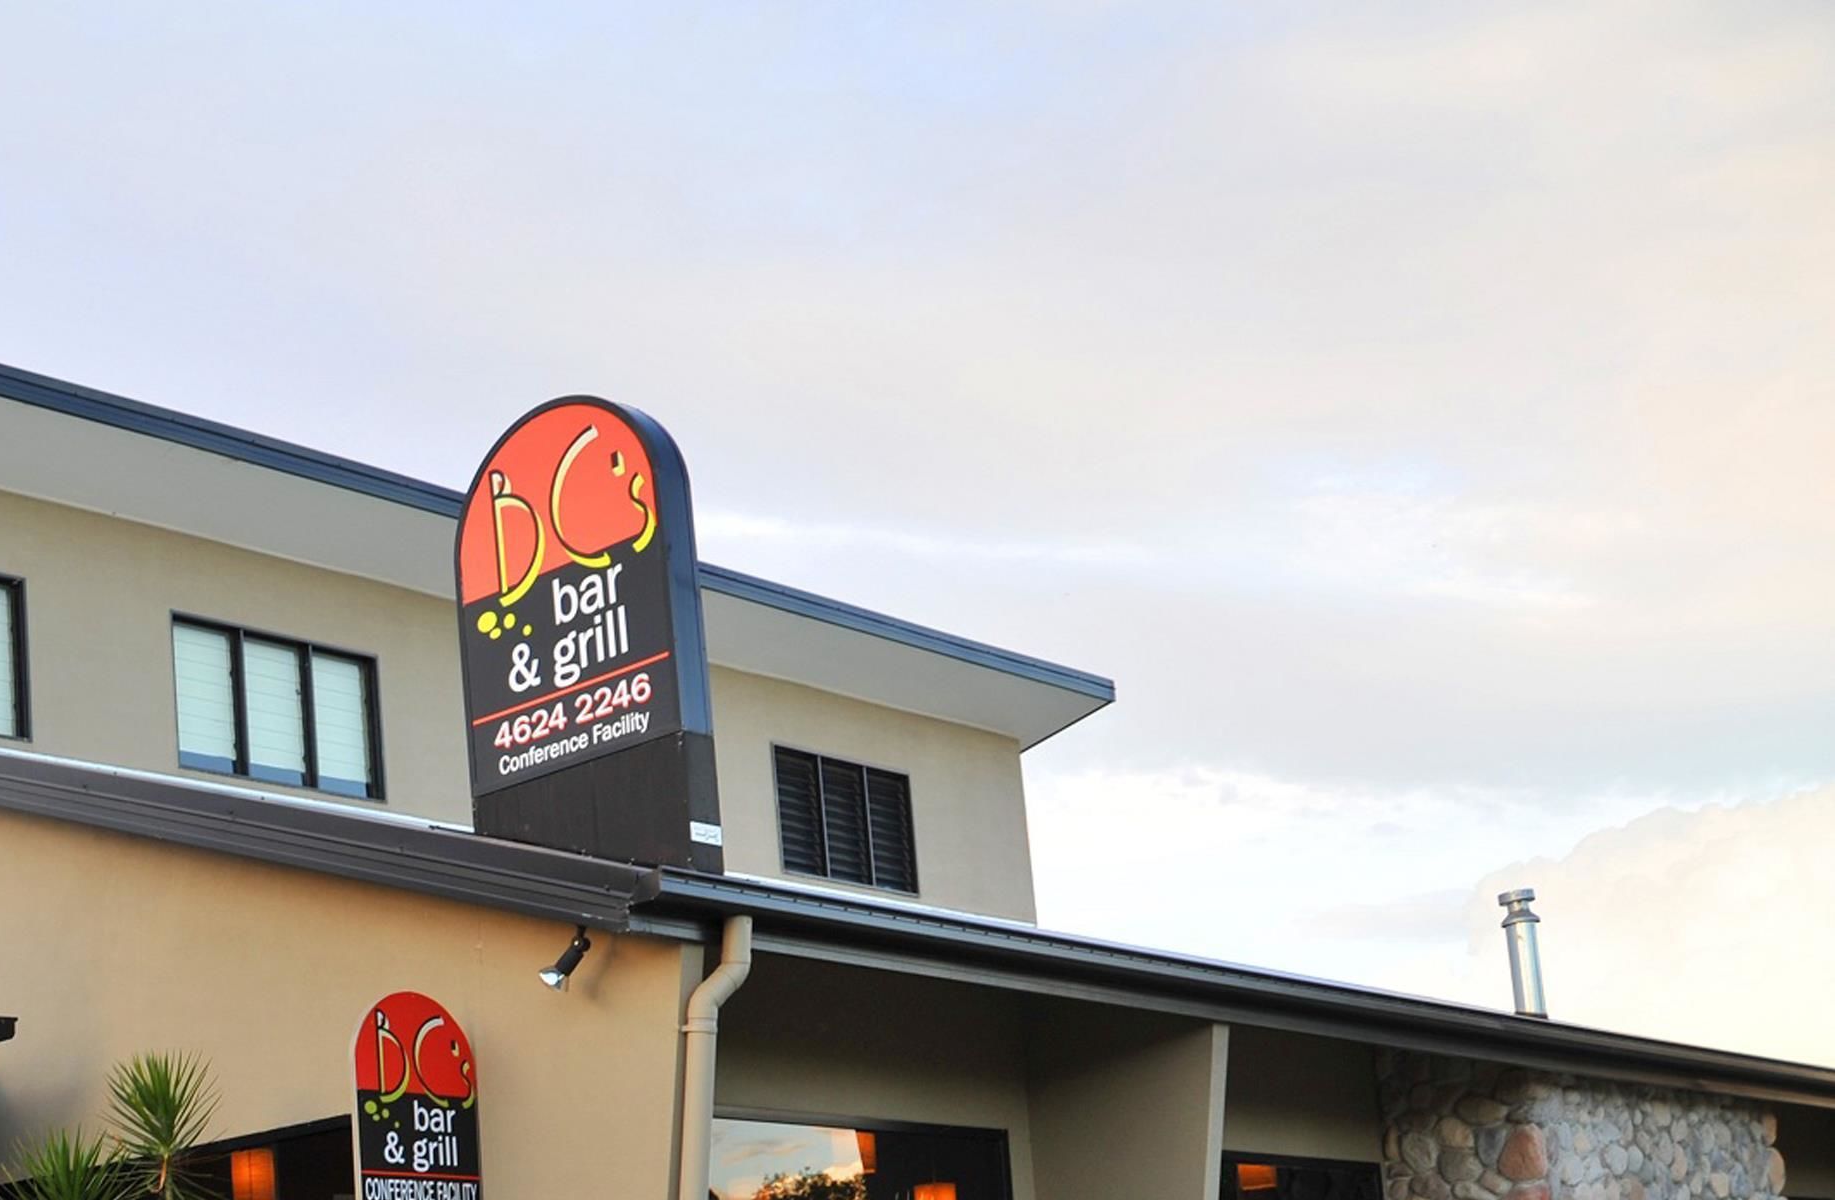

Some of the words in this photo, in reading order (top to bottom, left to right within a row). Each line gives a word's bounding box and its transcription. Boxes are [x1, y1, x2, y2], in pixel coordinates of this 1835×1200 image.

[489, 424, 658, 607] BC's
[553, 563, 623, 625] bar
[508, 642, 541, 692] &
[553, 604, 629, 688] grill
[493, 699, 567, 749] 4624
[574, 673, 653, 724] 2246
[499, 728, 588, 775] Conference
[593, 710, 650, 744] Facility
[375, 1007, 477, 1109] BC's
[383, 1131, 405, 1164] &
[412, 1136, 458, 1172] grill
[413, 1100, 456, 1133] bar
